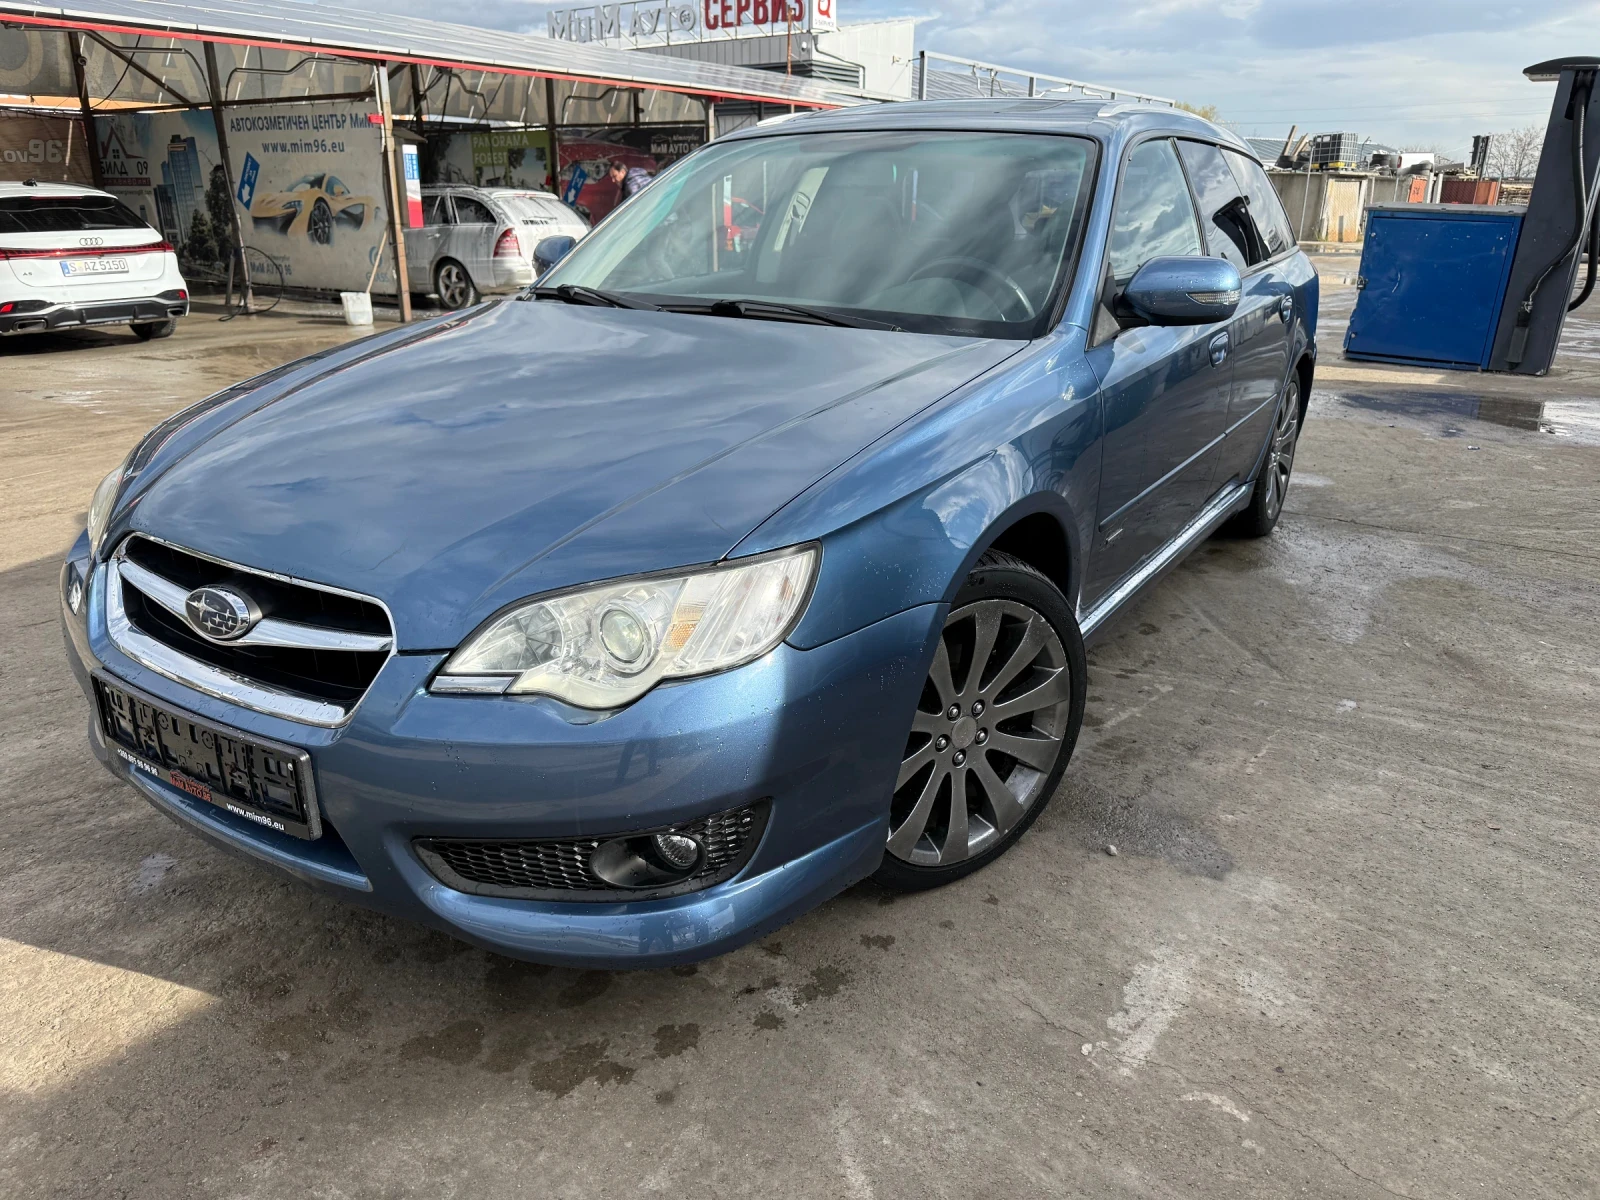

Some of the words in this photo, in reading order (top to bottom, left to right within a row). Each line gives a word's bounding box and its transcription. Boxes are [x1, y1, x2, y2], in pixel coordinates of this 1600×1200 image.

[705, 0, 805, 30] СЕРВИЗ
[230, 114, 309, 132] АВТОКОЗМЕТИЧЕН
[311, 114, 347, 132] ЦЕНТЪР
[261, 139, 345, 153] www.mim96.eu
[472, 134, 529, 148] PANORAMA
[474, 151, 508, 164] FOREST
[136, 160, 148, 175] 09
[69, 262, 77, 272] S
[84, 261, 98, 271] AZ
[100, 259, 126, 270] 5150
[226, 802, 285, 831] www.mim96.eu
